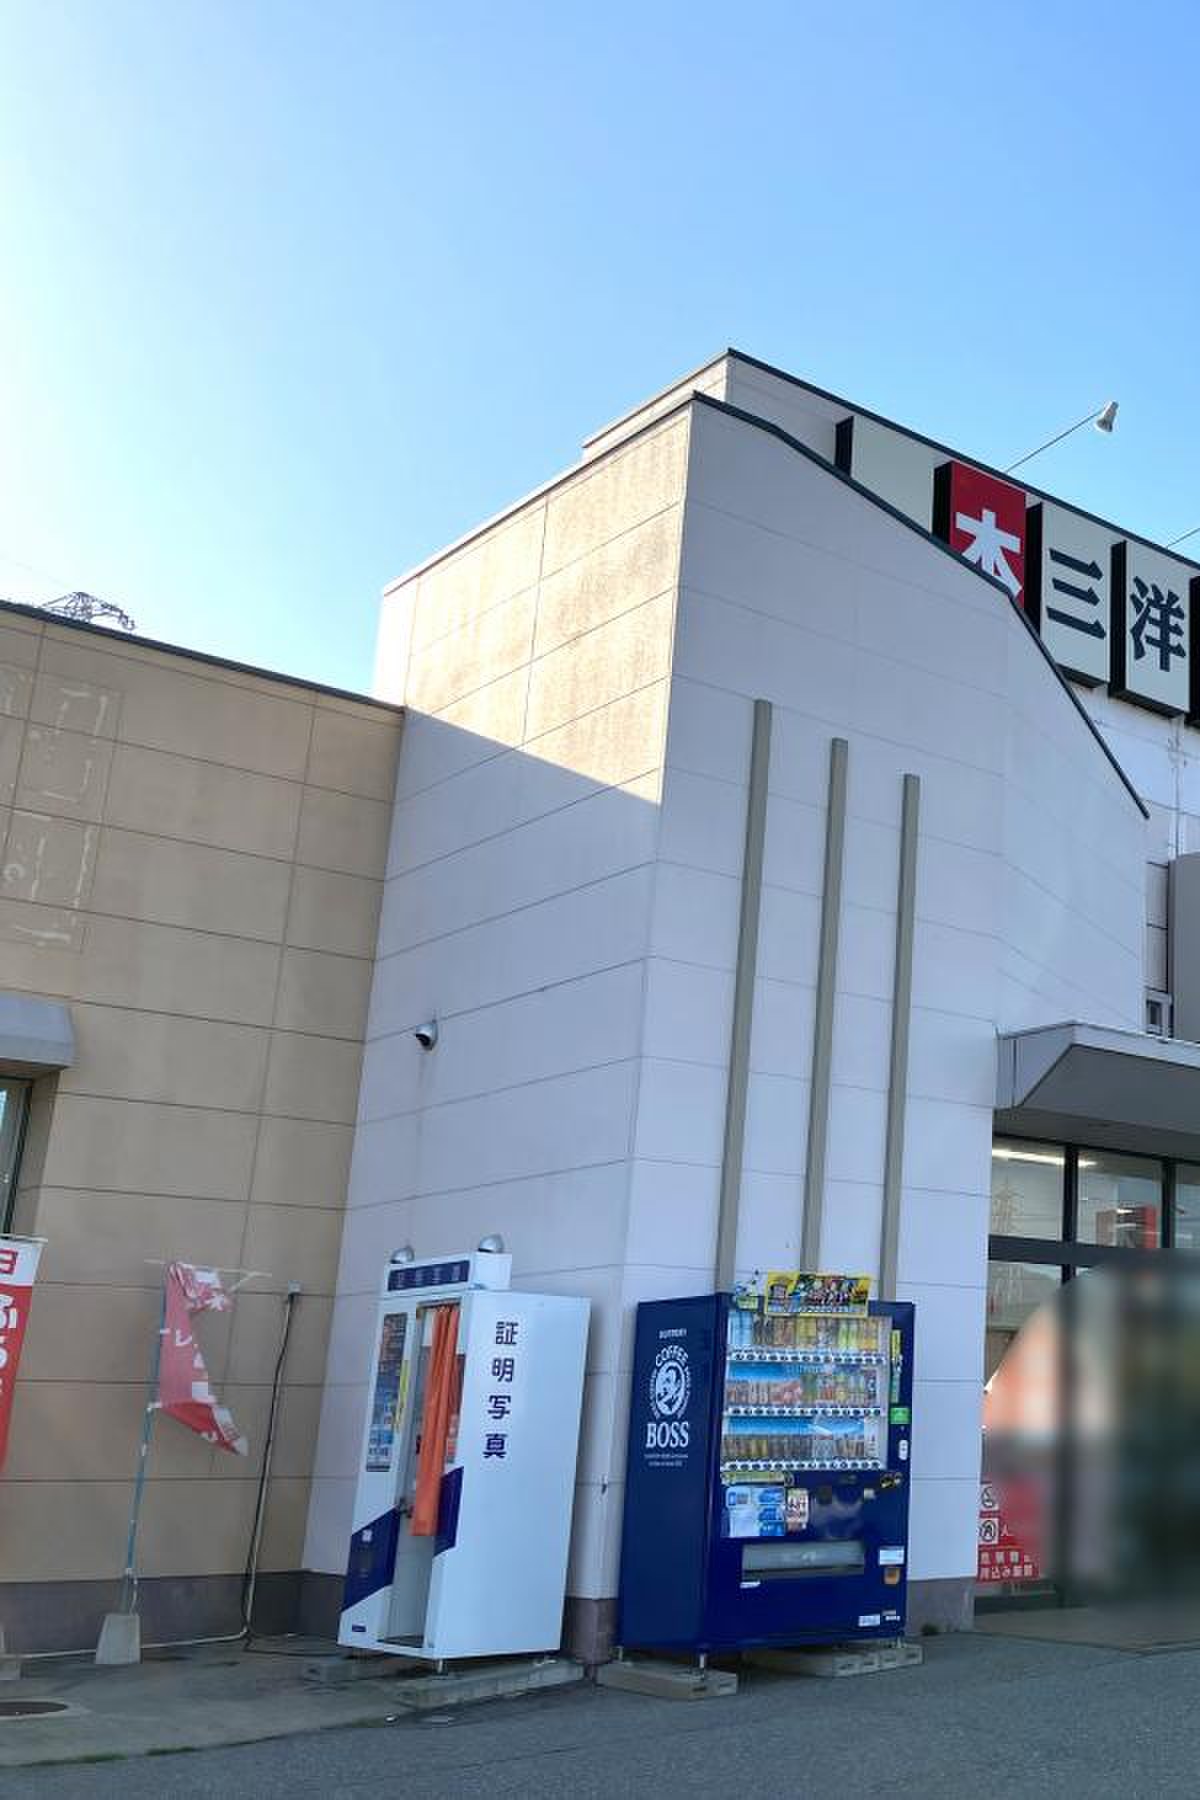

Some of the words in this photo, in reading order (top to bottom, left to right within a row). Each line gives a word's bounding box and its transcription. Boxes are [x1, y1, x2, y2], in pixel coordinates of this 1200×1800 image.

[482, 1321, 519, 1458] 証明写真
[645, 1421, 689, 1448] BOSS
